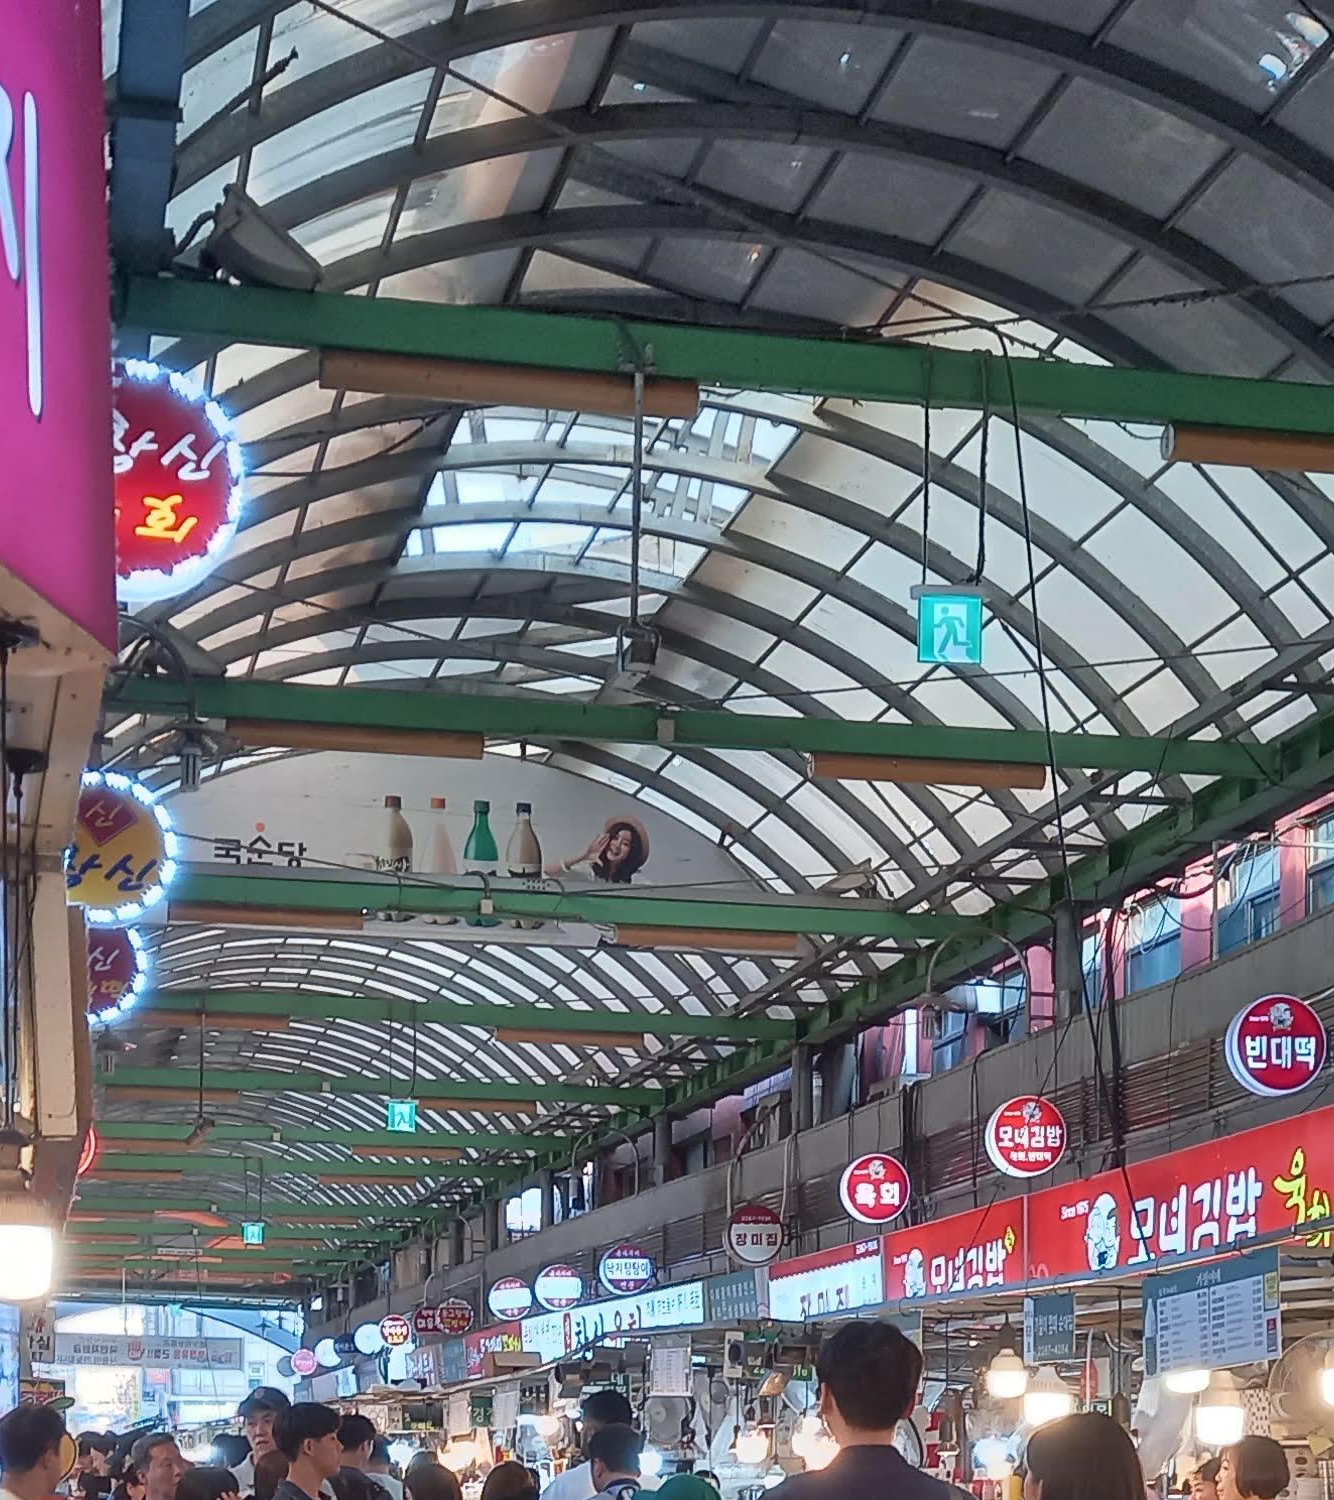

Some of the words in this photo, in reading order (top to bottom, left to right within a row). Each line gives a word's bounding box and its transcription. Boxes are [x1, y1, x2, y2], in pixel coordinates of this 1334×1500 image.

[1245, 1035, 1316, 1071] 빈대떡
[998, 1124, 1062, 1149] 모녀김밥
[1127, 1166, 1263, 1265] 모녀김밥
[735, 1232, 779, 1247] 장미집
